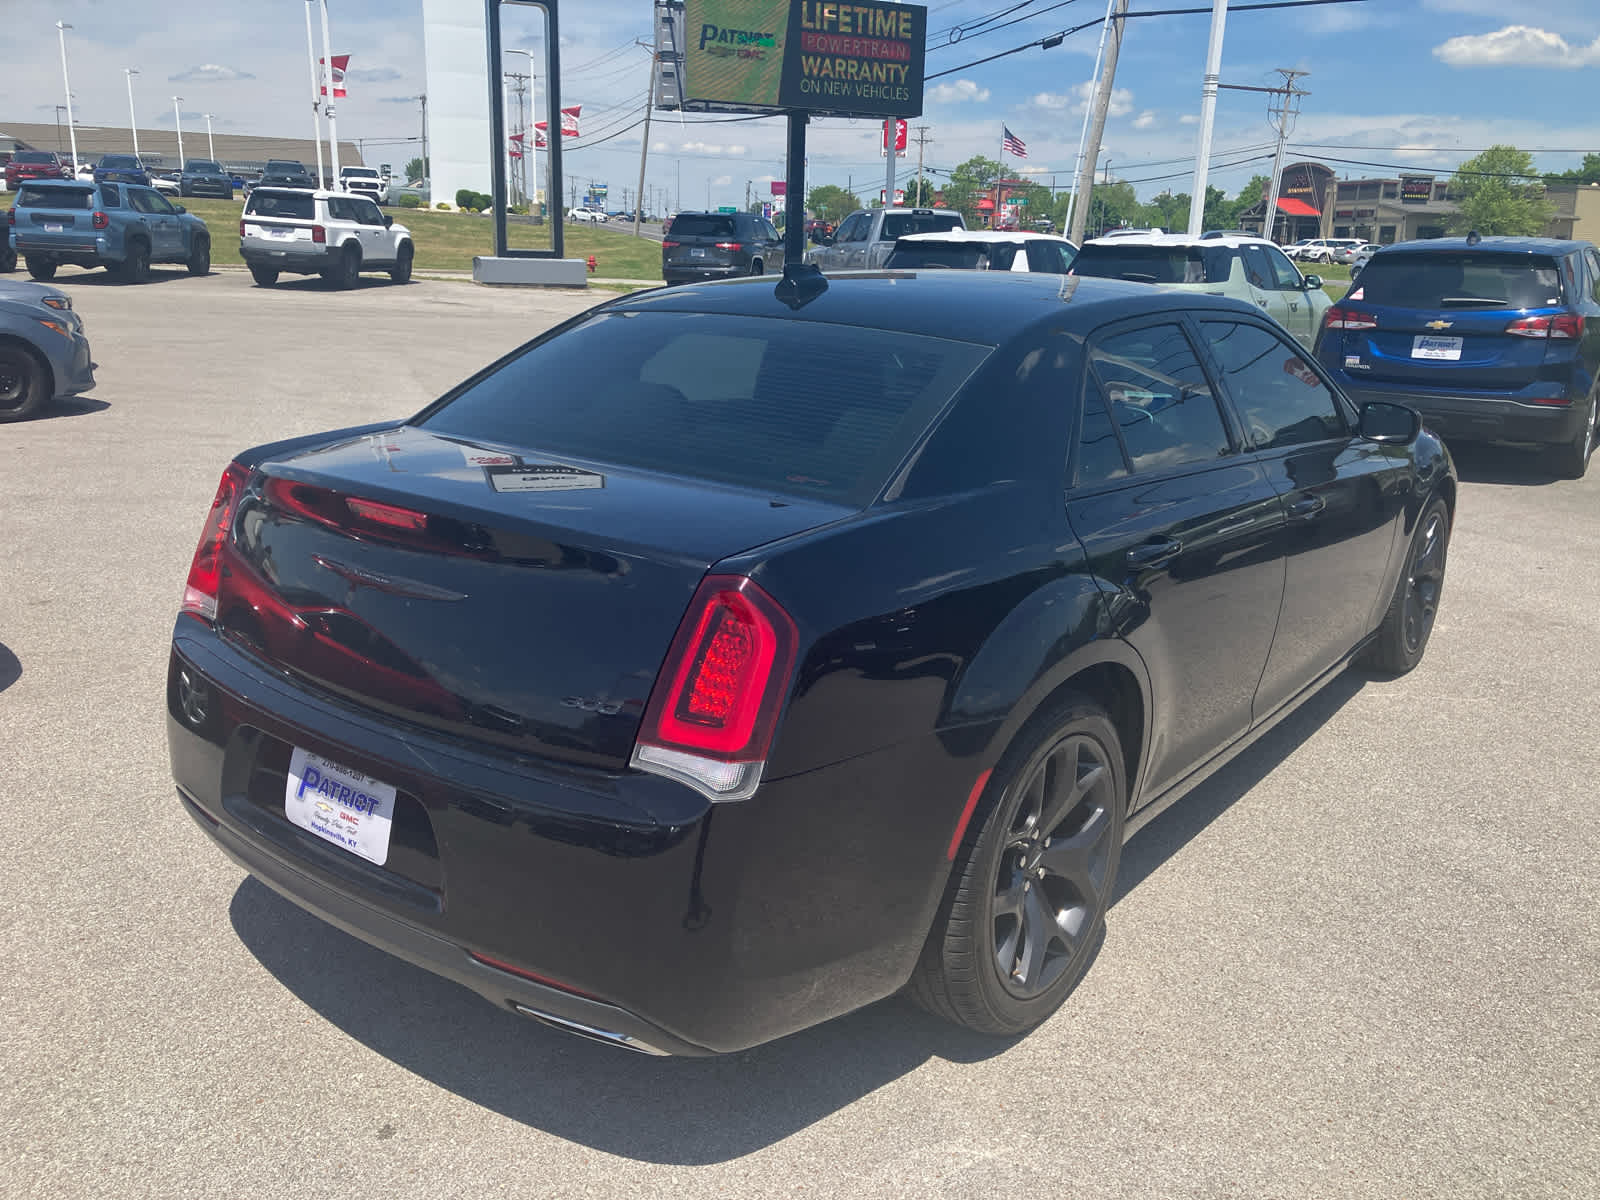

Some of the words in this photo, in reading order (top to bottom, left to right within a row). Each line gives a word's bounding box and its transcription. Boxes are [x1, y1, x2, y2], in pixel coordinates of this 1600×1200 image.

[801, 1, 912, 39] LIFETIME
[808, 34, 906, 58] POWERTRAIN
[801, 55, 910, 84] WARRANTY
[800, 79, 821, 94] ON
[824, 81, 851, 96] NEW
[855, 83, 910, 101] VEHICLES
[298, 766, 380, 816] PATRIOT
[339, 811, 359, 826] GMC
[311, 821, 347, 845] Hopkinsville,
[347, 838, 358, 848] KY
